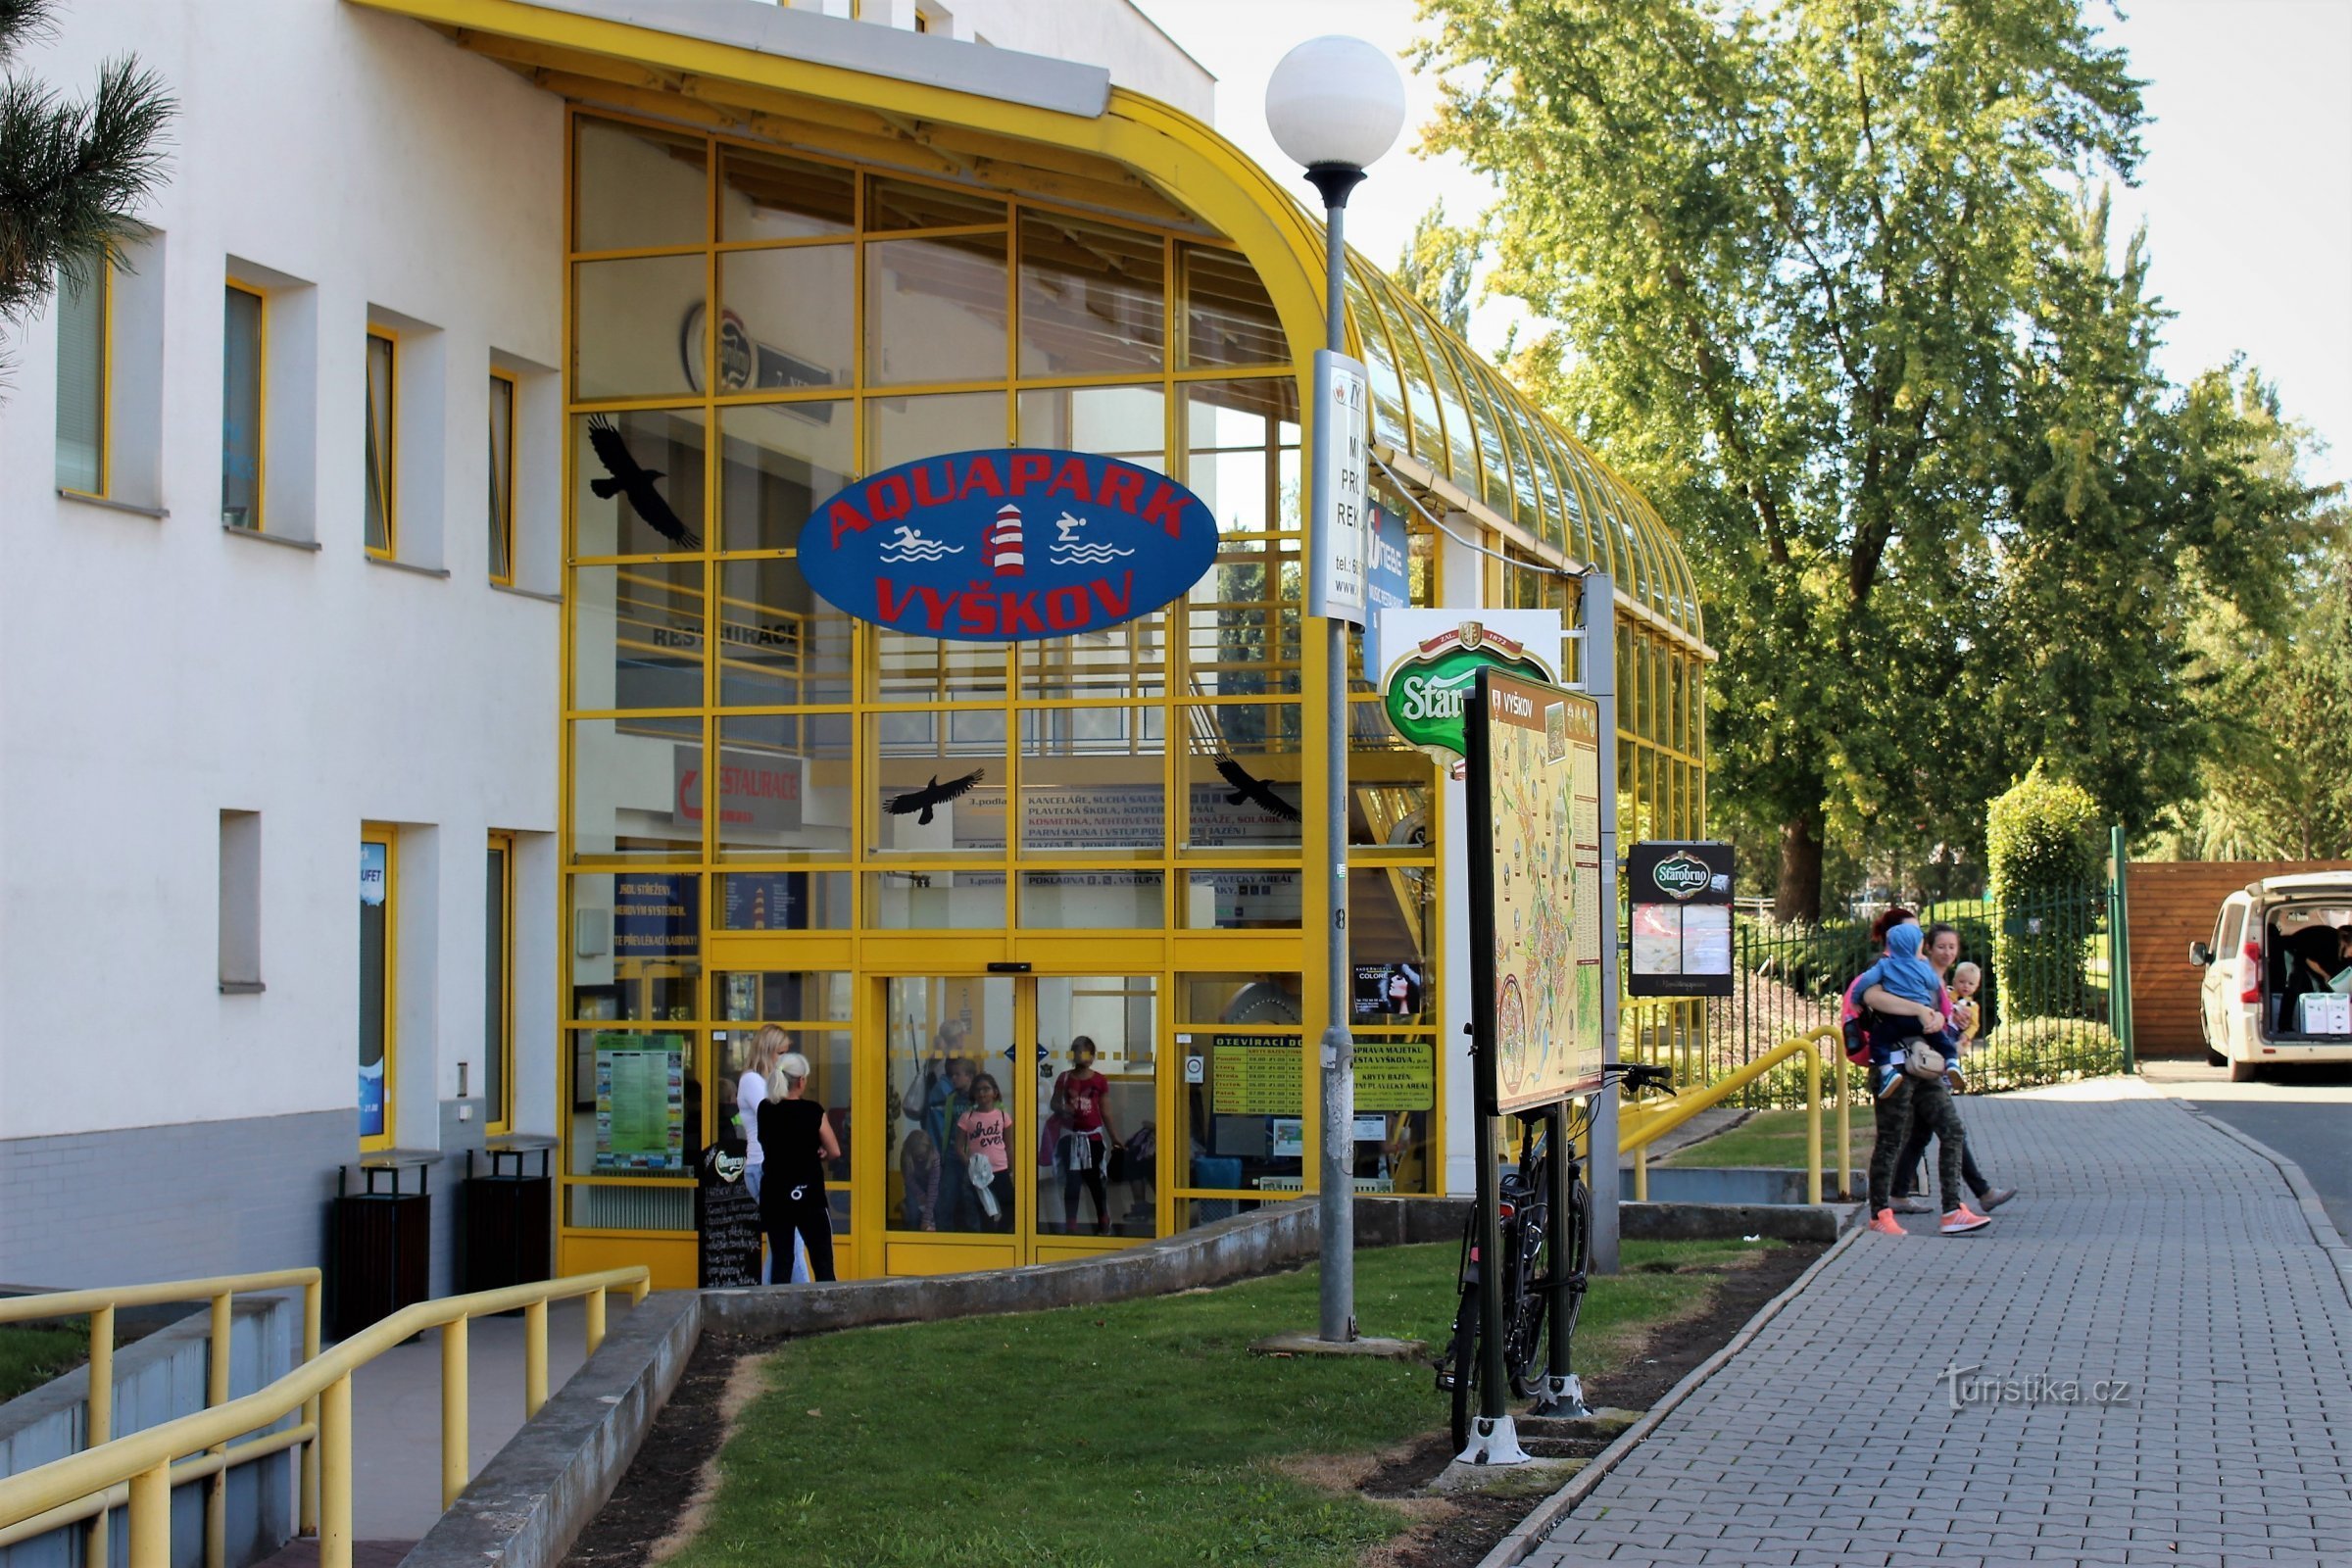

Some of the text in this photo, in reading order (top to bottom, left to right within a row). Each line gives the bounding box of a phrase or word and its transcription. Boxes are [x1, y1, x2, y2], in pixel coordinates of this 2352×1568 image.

[826, 454, 1196, 551] AQUAPARK
[875, 570, 1134, 635] VYŠKOV
[1440, 632, 1507, 646] ZAL. 1872
[1503, 691, 1533, 718] VYŠKOV
[1659, 863, 1706, 886] Starobrno
[1335, 908, 1345, 929] 8
[1216, 1037, 1284, 1046] OTEVÍRACÍ
[969, 1120, 1001, 1141] what
